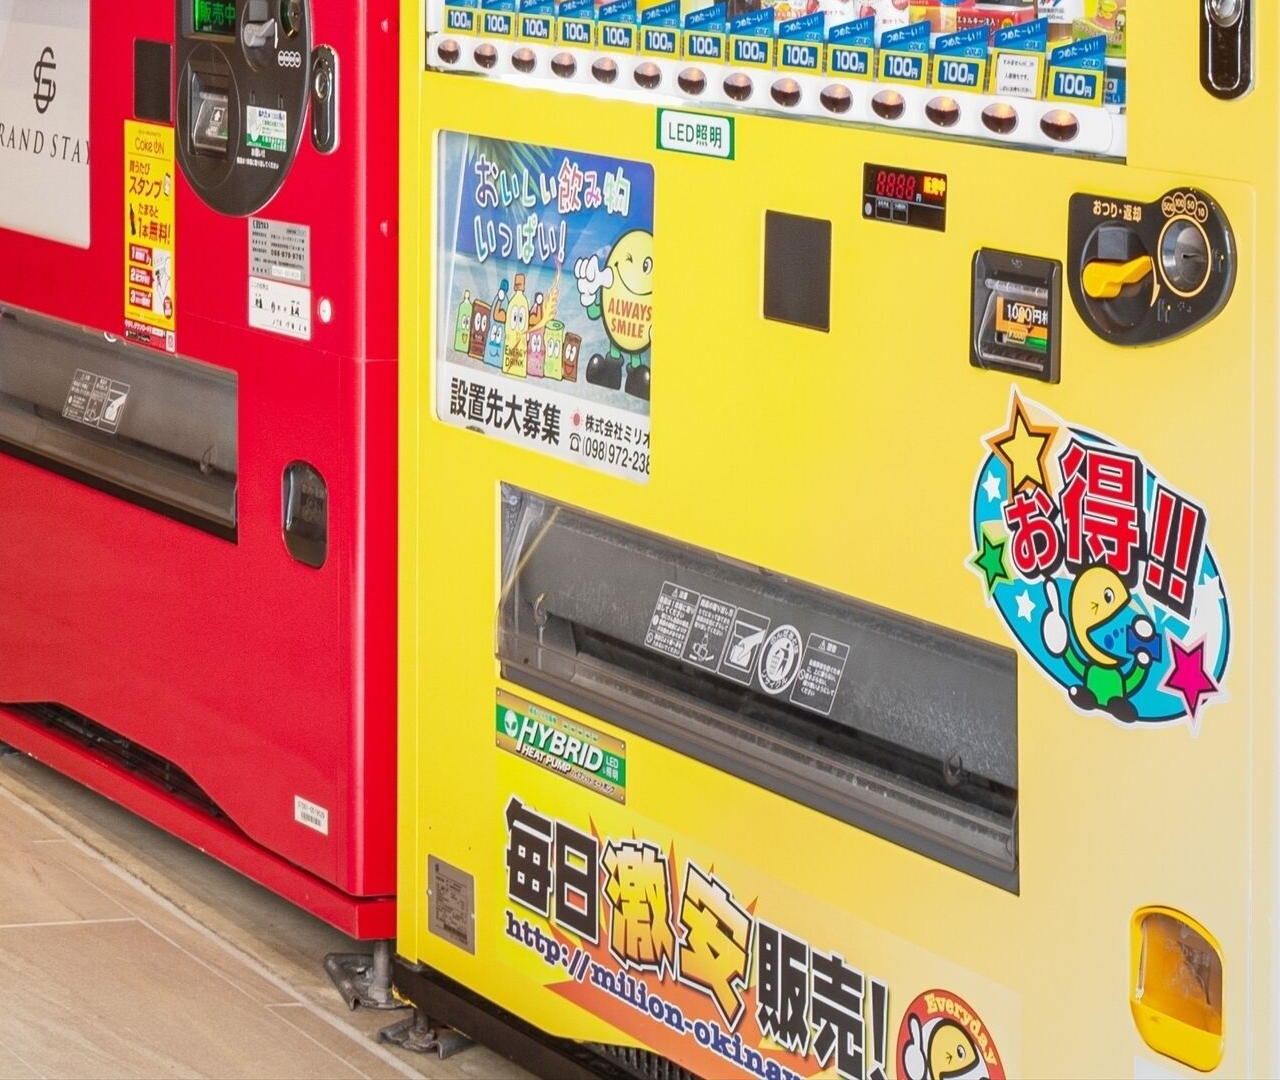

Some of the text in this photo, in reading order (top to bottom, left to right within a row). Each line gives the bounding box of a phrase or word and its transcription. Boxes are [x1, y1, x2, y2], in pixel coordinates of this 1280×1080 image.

[201, 0, 235, 25] 販売中
[450, 11, 471, 29] 100円
[487, 14, 509, 34] 100円
[525, 18, 547, 38] 100円
[565, 22, 588, 42] 100円
[606, 27, 629, 47] 100円
[649, 31, 673, 51] 100円
[692, 35, 718, 57] 100円
[738, 40, 765, 61] 100円
[786, 45, 815, 67] 100円
[836, 50, 865, 72] 100円
[888, 56, 918, 79] 100円
[943, 62, 975, 85] 100円
[1058, 74, 1093, 98] 100円
[135, 136, 152, 152] Coke
[668, 122, 723, 149] LED照明
[129, 176, 163, 199] スタンプ
[474, 153, 631, 217] おいしい飲み物
[138, 202, 159, 218] たまると
[1093, 199, 1142, 222] おつり・返却
[473, 212, 568, 265] いっぱい!
[607, 295, 653, 324] ALWAYS
[611, 317, 645, 340] SMILE
[504, 354, 525, 369] DRINK
[505, 345, 526, 360] ENERGY
[449, 376, 562, 447] 設置先大募集
[1004, 441, 1203, 612] お得!!
[516, 716, 603, 772] HYBRID
[522, 742, 572, 775] HEAT PUMP
[606, 755, 619, 769] LED
[923, 991, 998, 1067] Everyday
